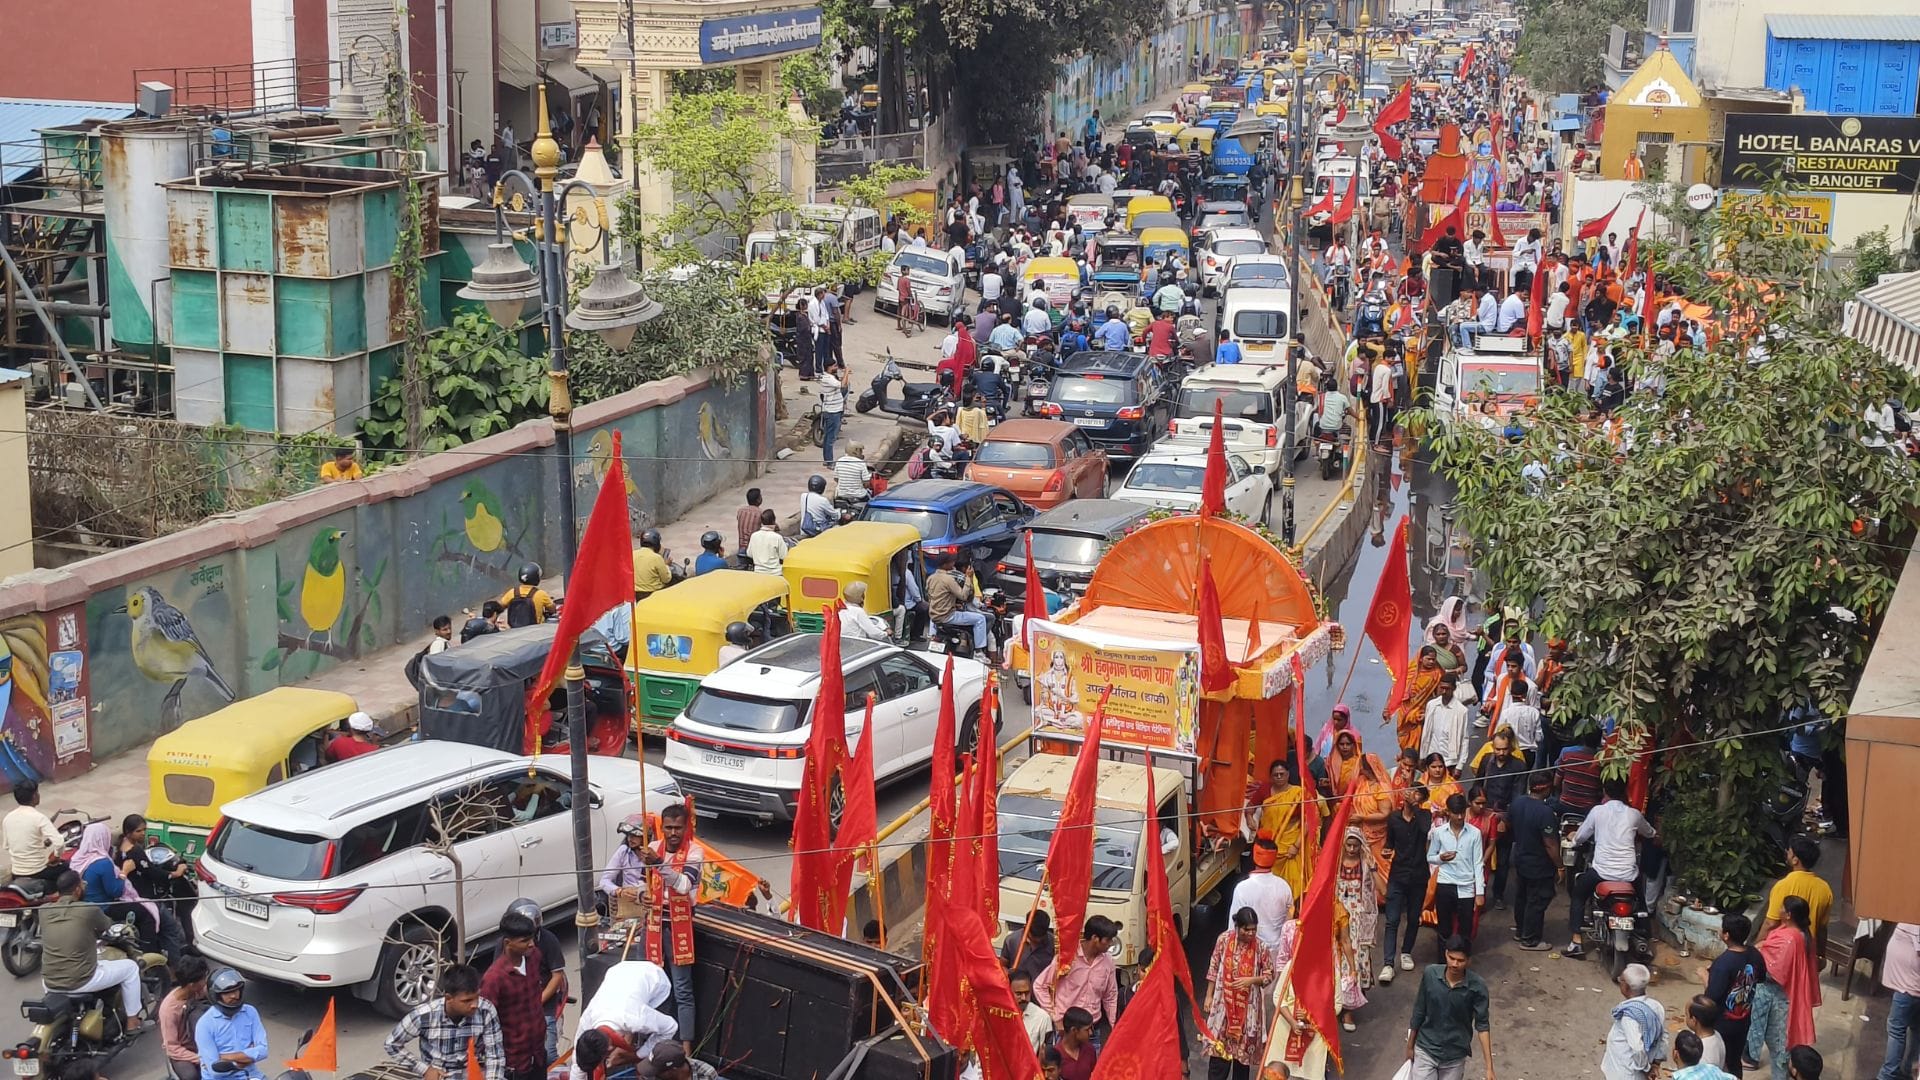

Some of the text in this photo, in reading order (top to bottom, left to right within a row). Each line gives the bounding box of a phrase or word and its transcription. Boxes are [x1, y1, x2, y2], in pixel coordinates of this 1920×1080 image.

[1738, 134, 1805, 151] HOTEL
[1810, 137, 1903, 154] BANARAS
[1796, 157, 1900, 172] RESTAURANT
[1809, 174, 1884, 189] BANQUET
[1081, 652, 1175, 687] श्री हनुमान ध्वजा यात्रा
[1086, 683, 1137, 699] उपकर्यालय
